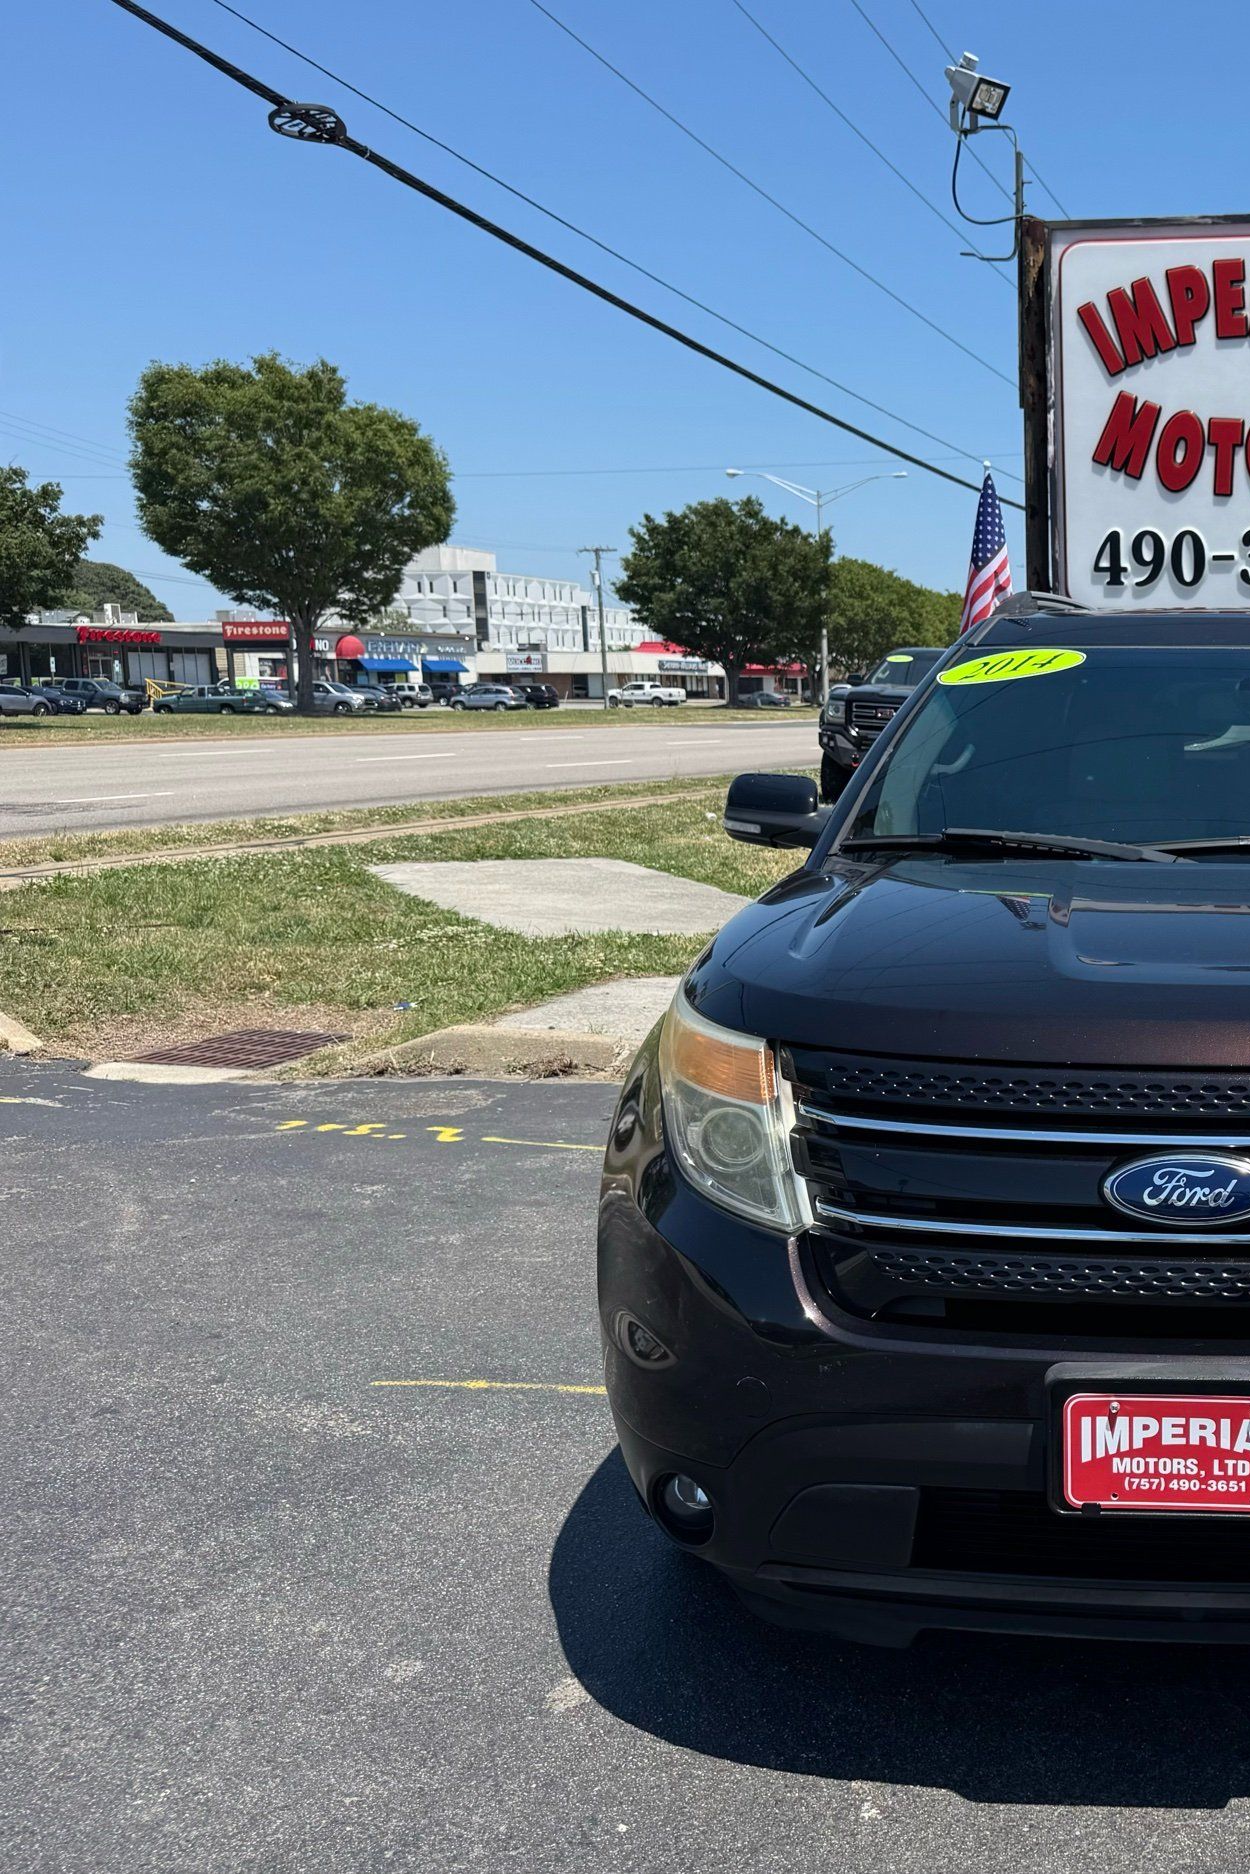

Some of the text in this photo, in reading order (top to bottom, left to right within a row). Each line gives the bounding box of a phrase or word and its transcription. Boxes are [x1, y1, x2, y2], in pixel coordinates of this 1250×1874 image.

[225, 625, 288, 637] Firestone
[958, 652, 1065, 681] 2014
[1143, 1167, 1238, 1208] Ford
[1112, 1457, 1206, 1477] MOTORS,
[1124, 1476, 1246, 1493] (757) 490-3651
